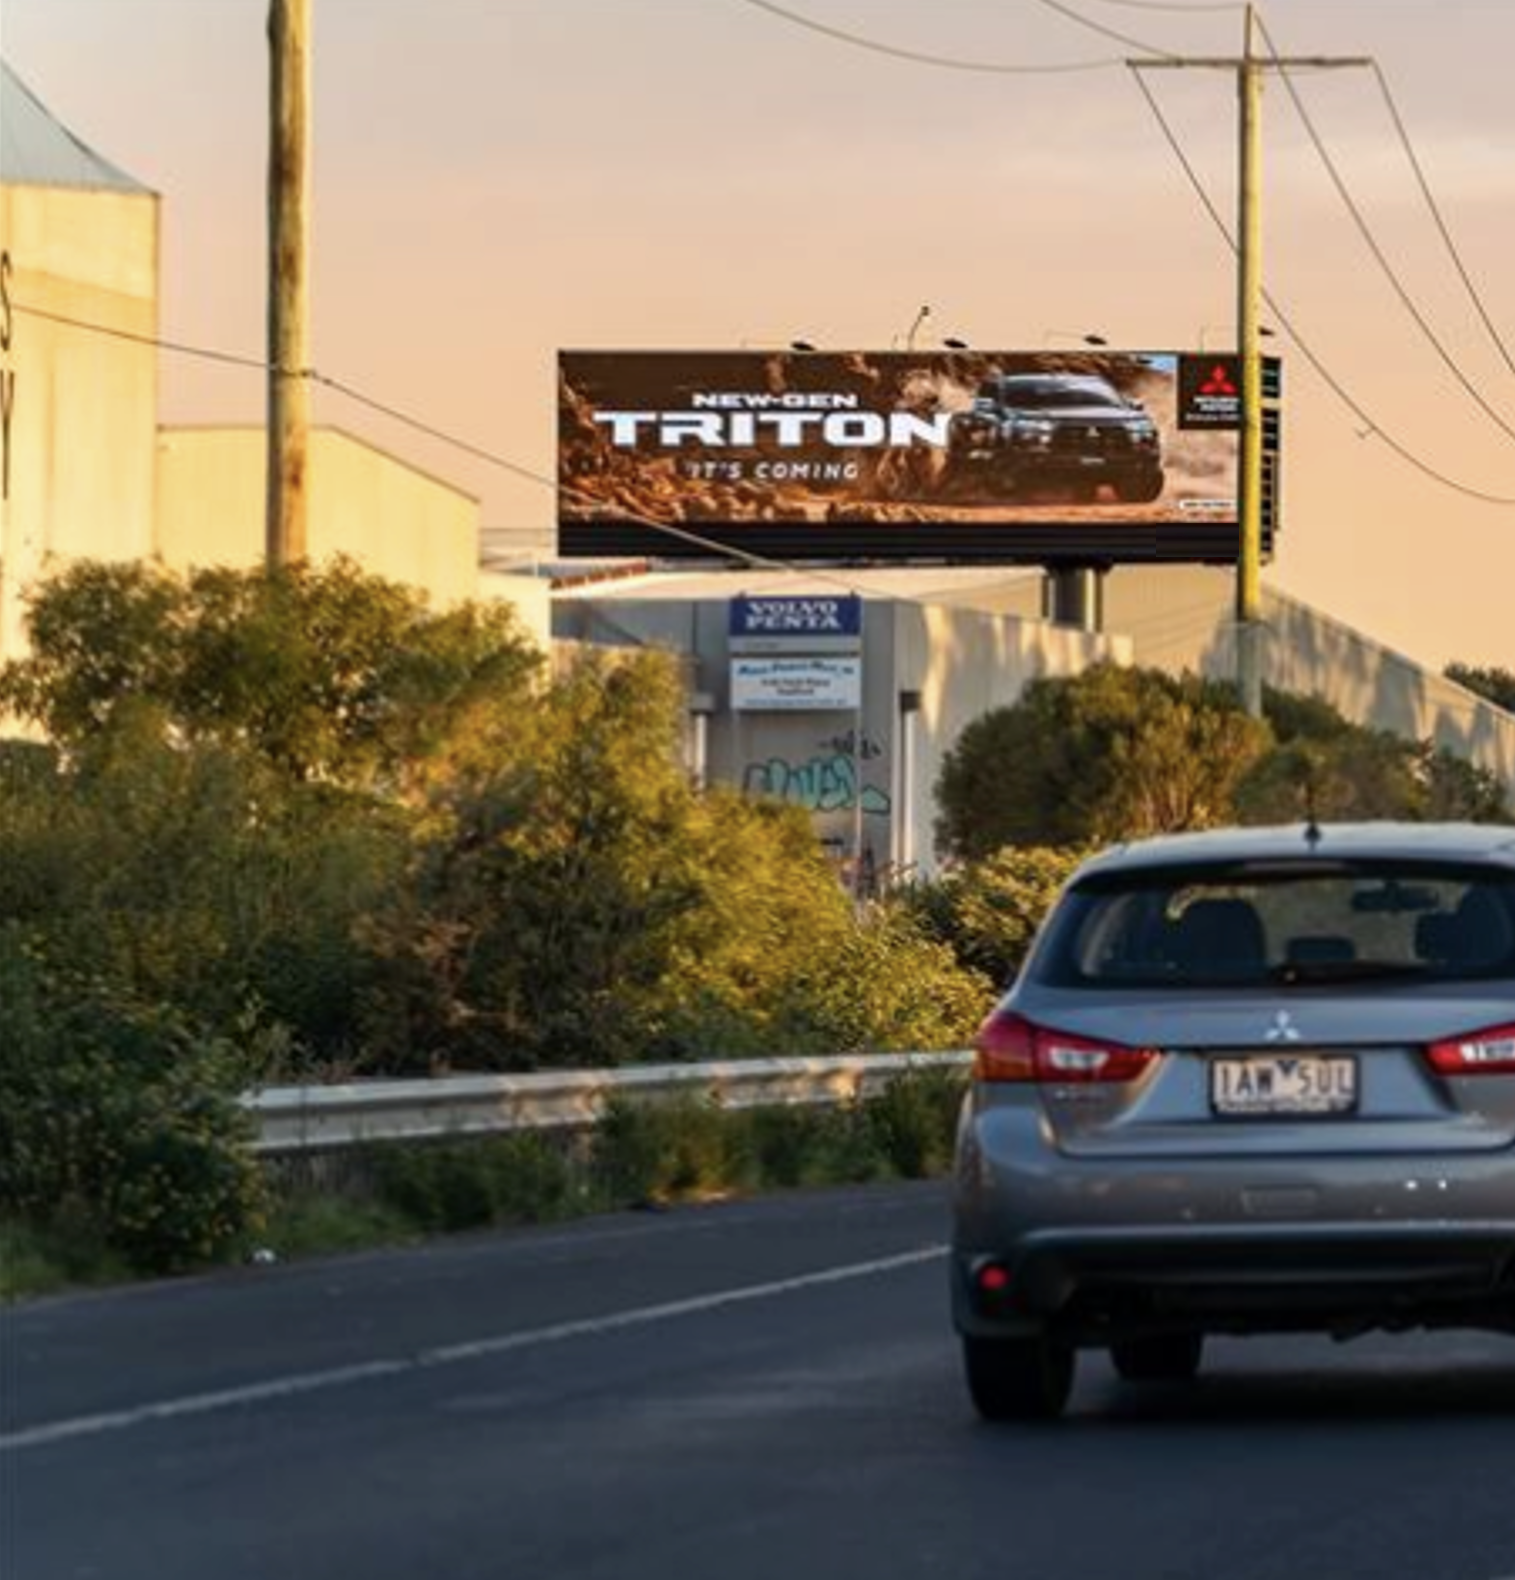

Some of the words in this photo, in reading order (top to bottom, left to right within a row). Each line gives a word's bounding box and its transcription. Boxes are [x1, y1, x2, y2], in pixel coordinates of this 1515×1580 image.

[692, 393, 858, 408] NEW-GEN
[593, 411, 951, 447] TRITON
[755, 462, 858, 480] COMING
[748, 601, 839, 615] VOLVO
[746, 615, 841, 630] PENTA
